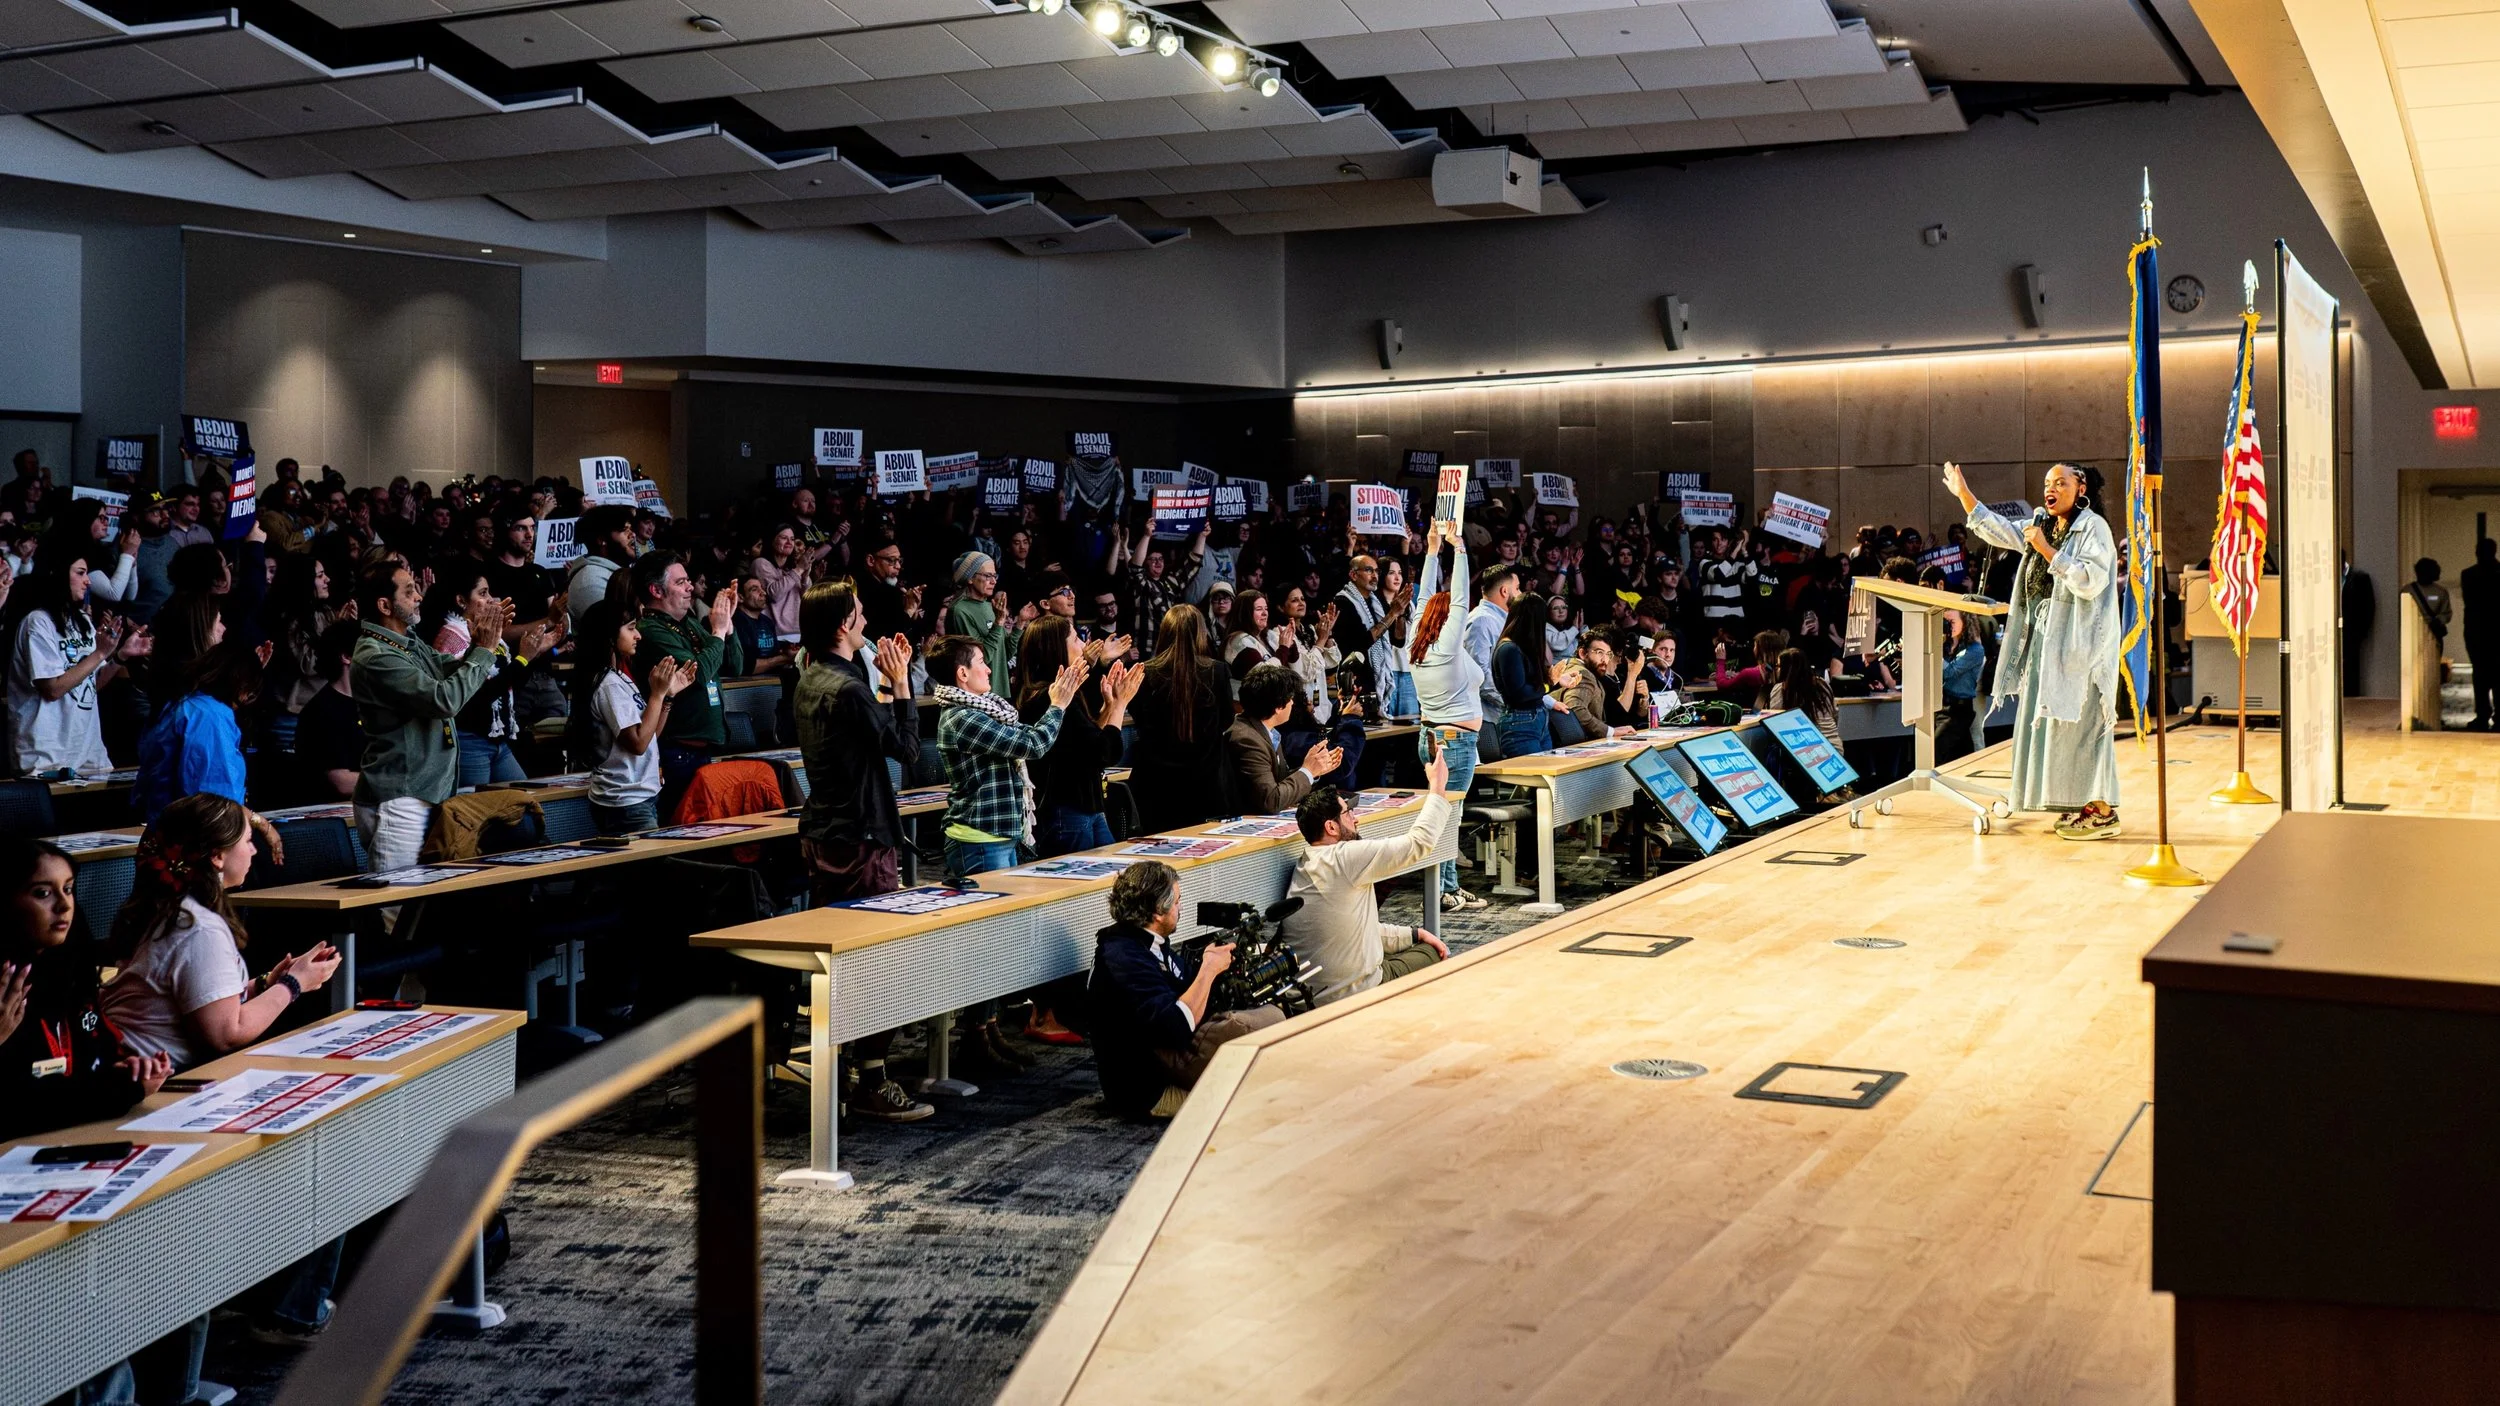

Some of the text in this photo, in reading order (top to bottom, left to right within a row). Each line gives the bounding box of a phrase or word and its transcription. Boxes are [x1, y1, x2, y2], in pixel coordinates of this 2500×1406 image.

[601, 365, 621, 381] EXIT
[2443, 407, 2472, 428] EXIT
[194, 418, 239, 438] ABDUL
[205, 435, 239, 451] SENATE
[823, 431, 855, 447] ABDUL
[1074, 432, 1111, 445] ABDUL
[830, 447, 854, 458] SENATE
[1083, 445, 1111, 456] SENATE
[884, 453, 917, 470] ABDUL
[1410, 452, 1439, 465] ABDUL
[1024, 458, 1056, 478] ABDUL
[1483, 461, 1513, 473] ABDUL
[892, 471, 918, 483] SENATE
[929, 468, 977, 482] MEDICARE FOR ALL
[1030, 475, 1056, 489] SENATE
[1438, 470, 1461, 493] ENTS
[1667, 472, 1701, 488] ABDUL
[985, 477, 1019, 493] ABDUL
[1466, 480, 1484, 493] DUL
[1542, 475, 1569, 490] ABDUL
[598, 486, 608, 495] US
[1176, 489, 1187, 497] OUT
[1187, 489, 1194, 497] OF
[1214, 487, 1246, 504] ABDUL
[1466, 492, 1486, 503] ENATE
[992, 494, 1019, 505] SENATE
[1156, 499, 1176, 507] MONEY
[1357, 488, 1401, 509] STUDEN
[1155, 507, 1208, 519] MEDICARE FOR ALL
[1221, 503, 1247, 516] SENATE
[1357, 508, 1371, 516] FOR
[1777, 498, 1794, 508] MONEY
[1809, 507, 1827, 517] POLITICS
[1371, 506, 1405, 528] ABDU
[1773, 513, 1822, 535] MEDICARE FOR ALL
[1953, 561, 1964, 572] ALL
[1850, 588, 1869, 614] DUL
